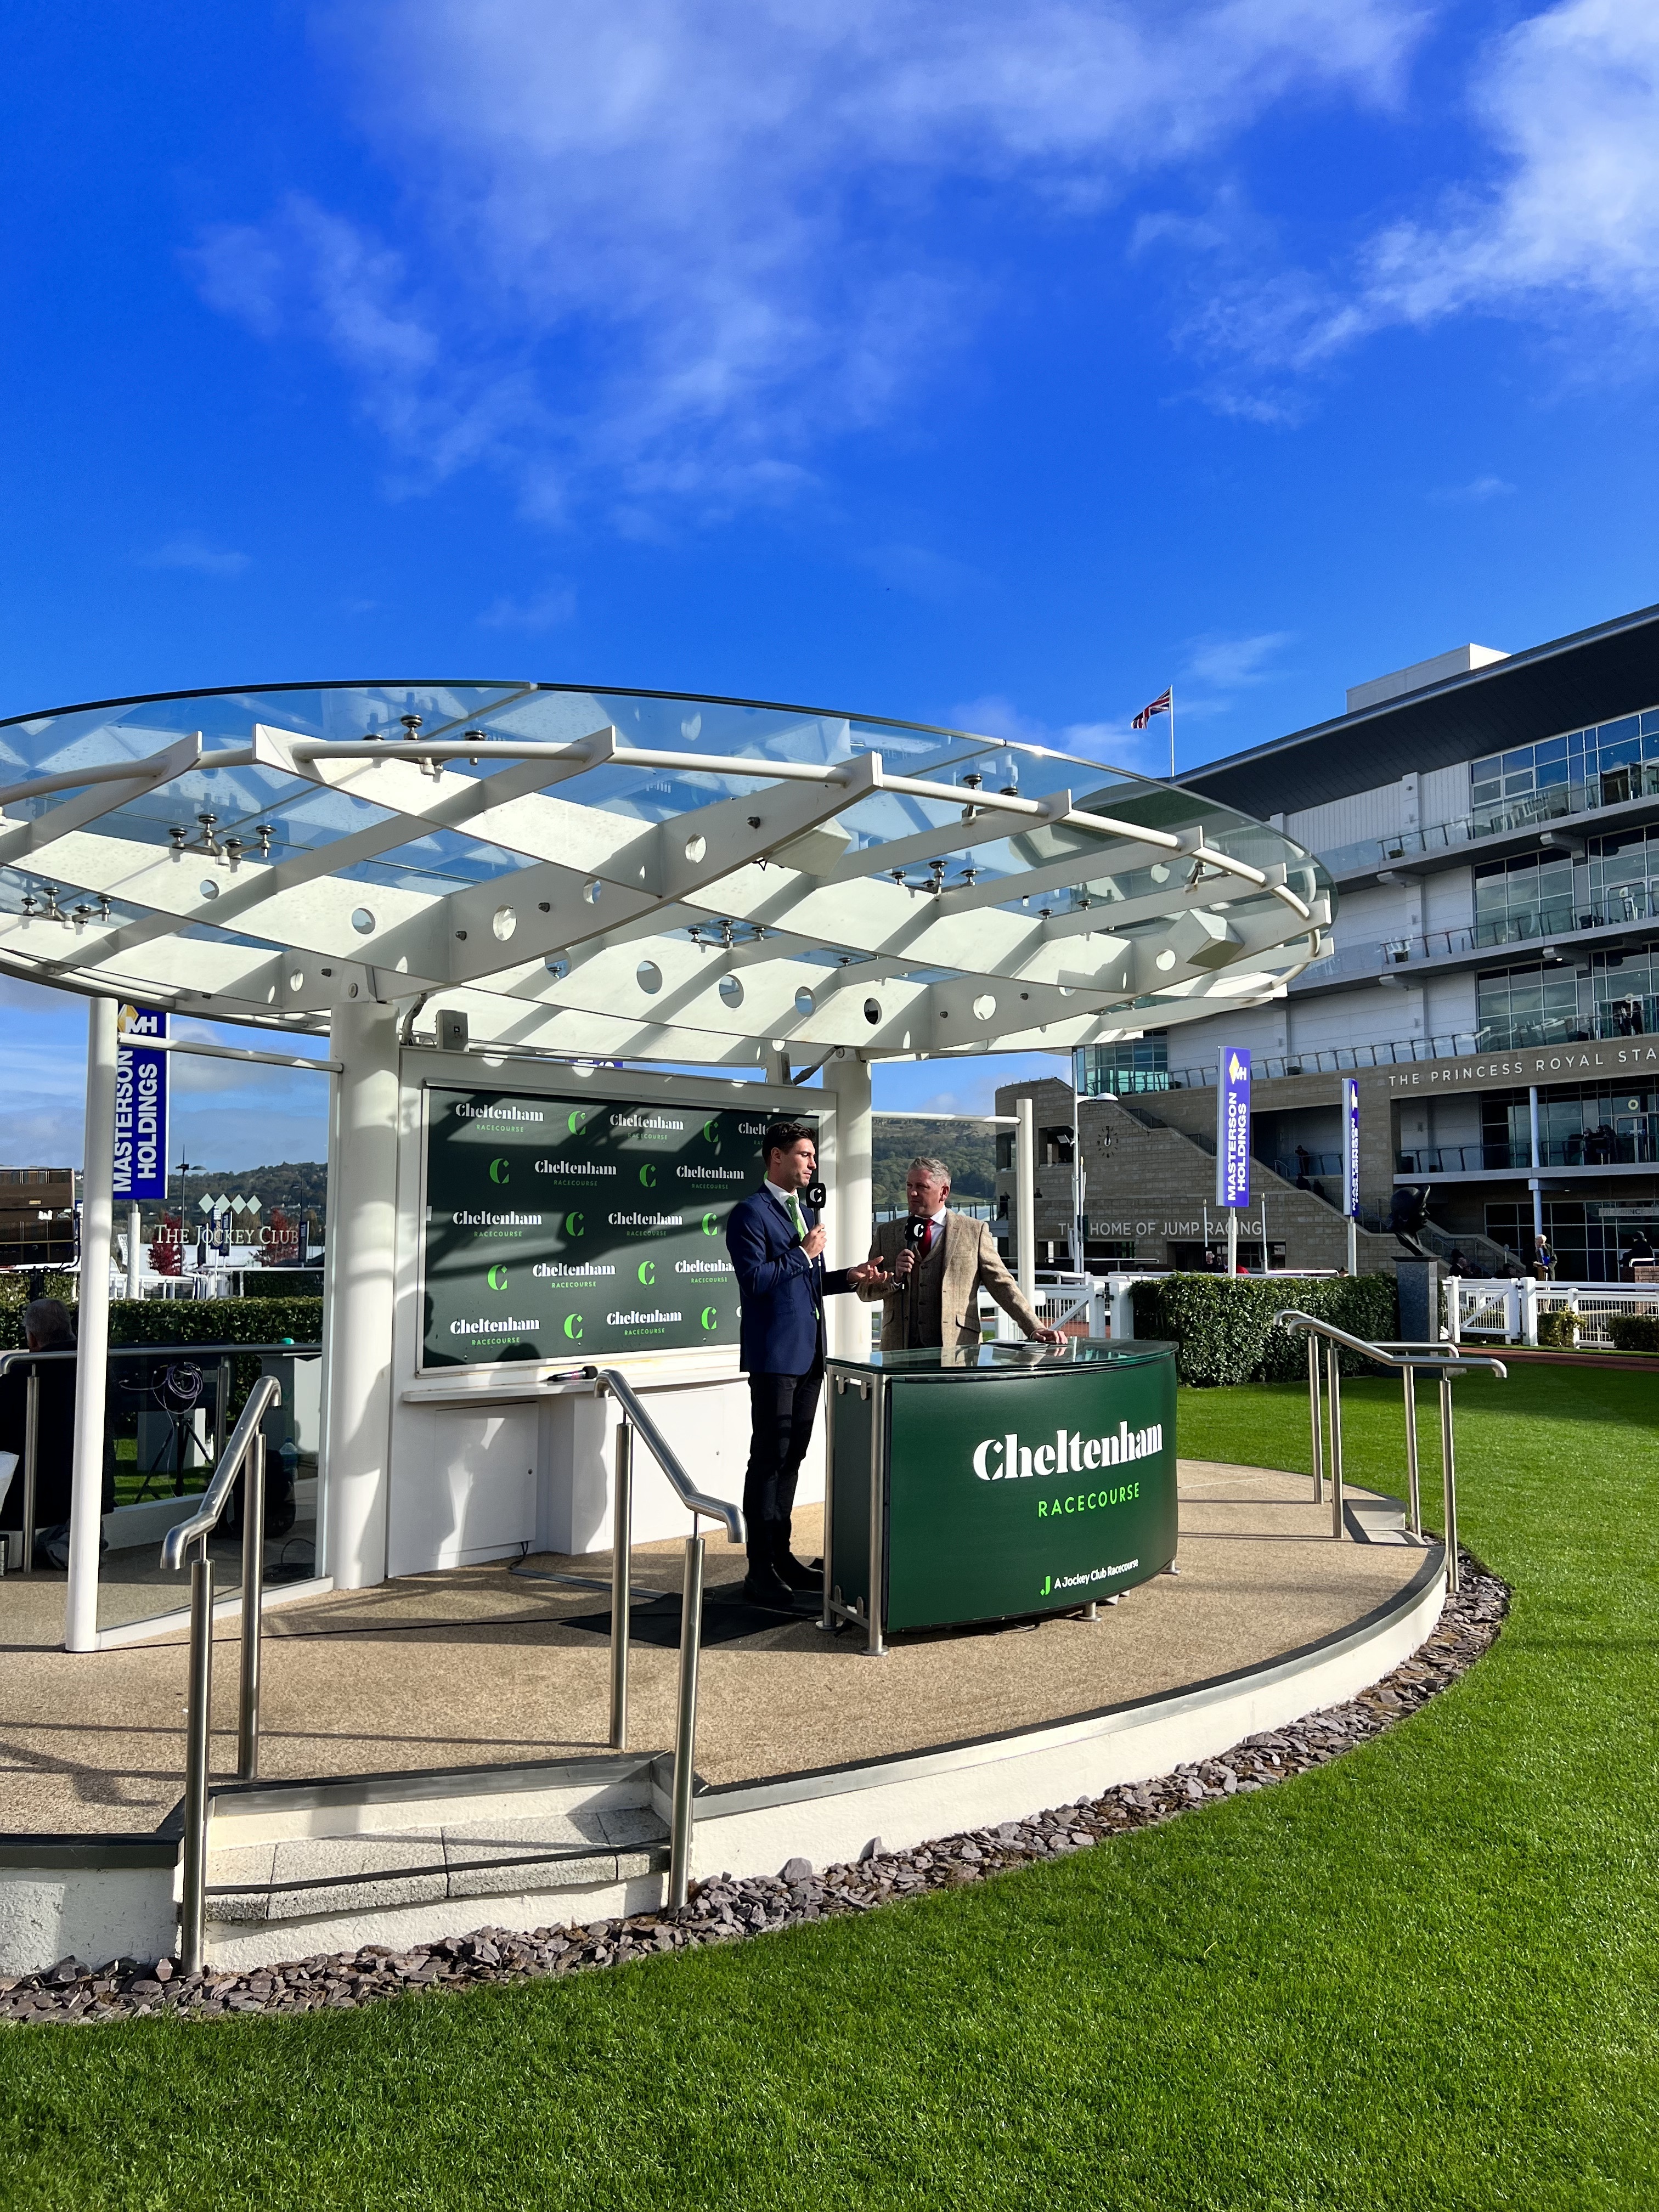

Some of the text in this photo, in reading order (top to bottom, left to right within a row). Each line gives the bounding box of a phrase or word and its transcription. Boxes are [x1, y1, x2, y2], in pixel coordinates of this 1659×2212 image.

[126, 1017, 157, 1033] MH
[1389, 1047, 1657, 1086] THE PRINCESS ROYAL STA
[455, 1103, 544, 1121] Cheltenham
[113, 1051, 133, 1192] MASTERSON
[138, 1063, 157, 1178] HOLDINGS
[610, 1114, 684, 1130] Cheltenham
[738, 1122, 766, 1135] Chelt
[1228, 1092, 1237, 1201] MASTERSON
[1238, 1103, 1246, 1191] HOLDINGS
[535, 1160, 617, 1176] Cheltenham
[676, 1165, 744, 1180] Cheltenham
[453, 1211, 542, 1225] Cheltenham
[608, 1212, 682, 1225] Cheltenham
[155, 1224, 189, 1244] THE
[196, 1226, 253, 1248] JOCKEY
[259, 1226, 299, 1244] CLUB
[1090, 1223, 1131, 1235] HOME
[1136, 1222, 1156, 1235] OF
[1161, 1222, 1199, 1235] JUMP
[533, 1262, 616, 1277] Cheltenham
[675, 1259, 735, 1273] Cheltenha
[450, 1317, 540, 1334] Cheltenham
[607, 1310, 682, 1325] Cheltenham
[472, 1337, 520, 1346] RACECOURSE
[973, 1421, 1163, 1481] Cheltenham
[1038, 1482, 1139, 1517] RACECOURSE
[1054, 1559, 1139, 1589] A Jockey Club Racecourse
